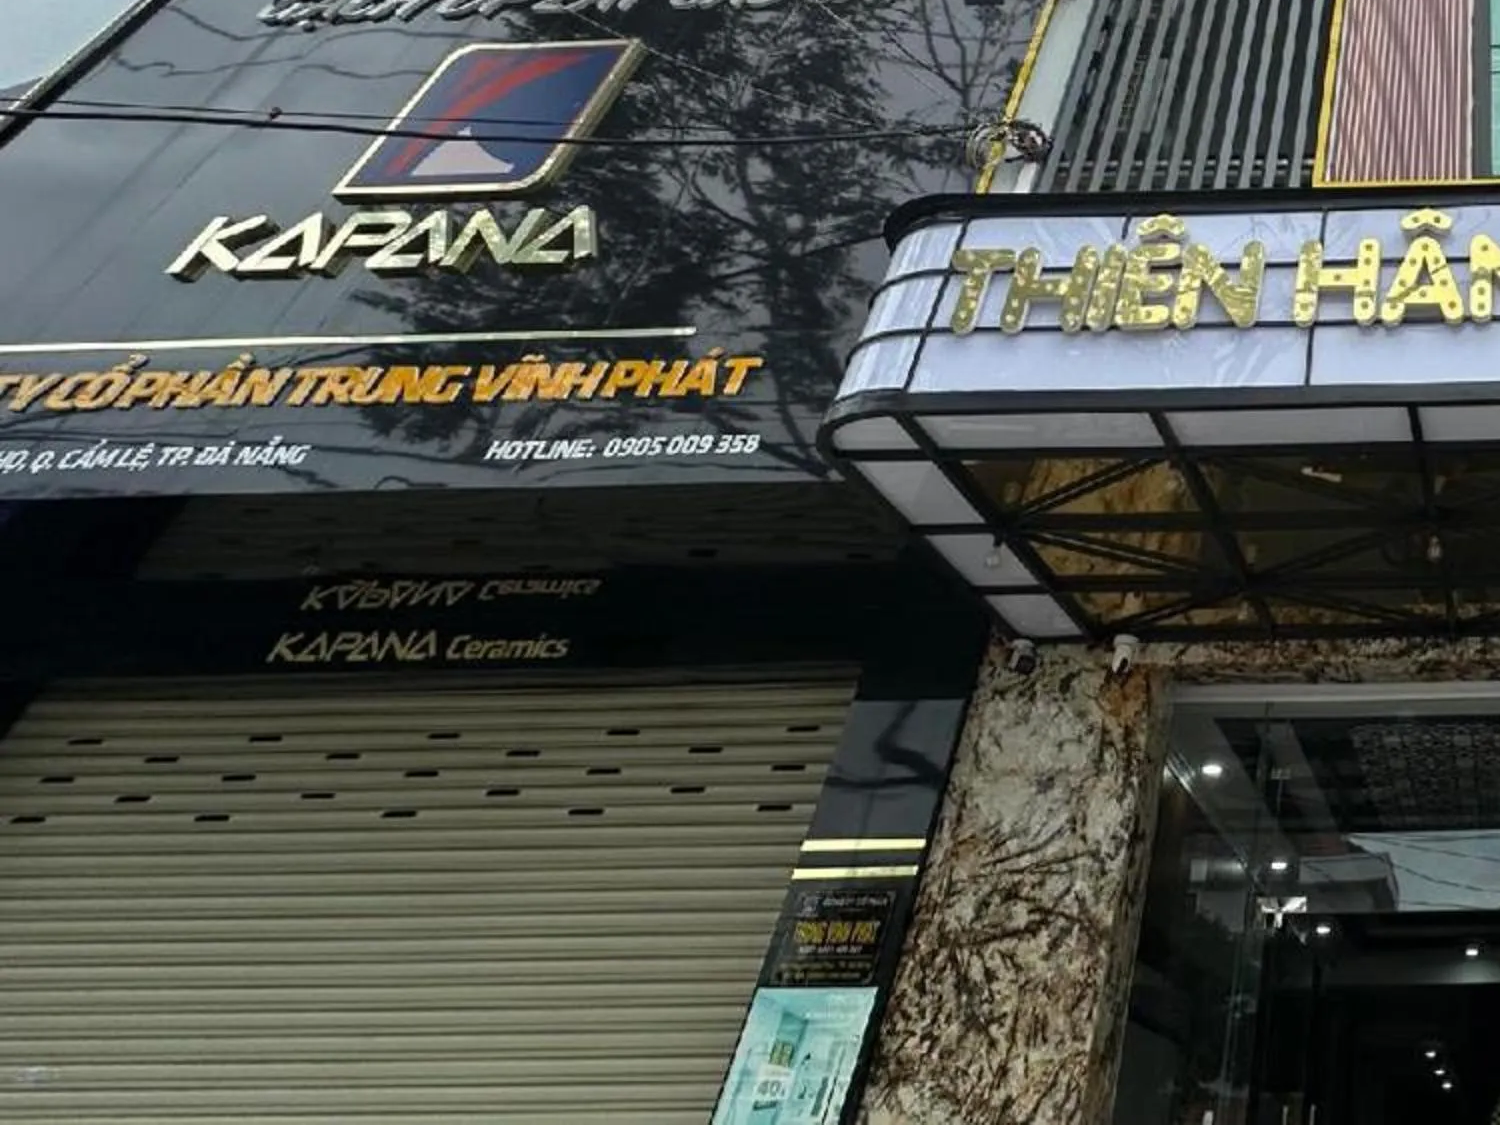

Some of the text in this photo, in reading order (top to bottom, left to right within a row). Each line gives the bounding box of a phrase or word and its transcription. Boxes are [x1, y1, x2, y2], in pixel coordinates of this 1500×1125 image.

[164, 204, 598, 280] KAPANA
[951, 212, 1267, 335] THIÊN
[285, 364, 471, 407] TRUNG
[600, 346, 764, 399] PHÁT
[484, 438, 597, 461] HOTLINE:
[602, 435, 668, 458] 0905
[714, 433, 761, 455] 358
[265, 629, 571, 664] KAPANA Ceramics
